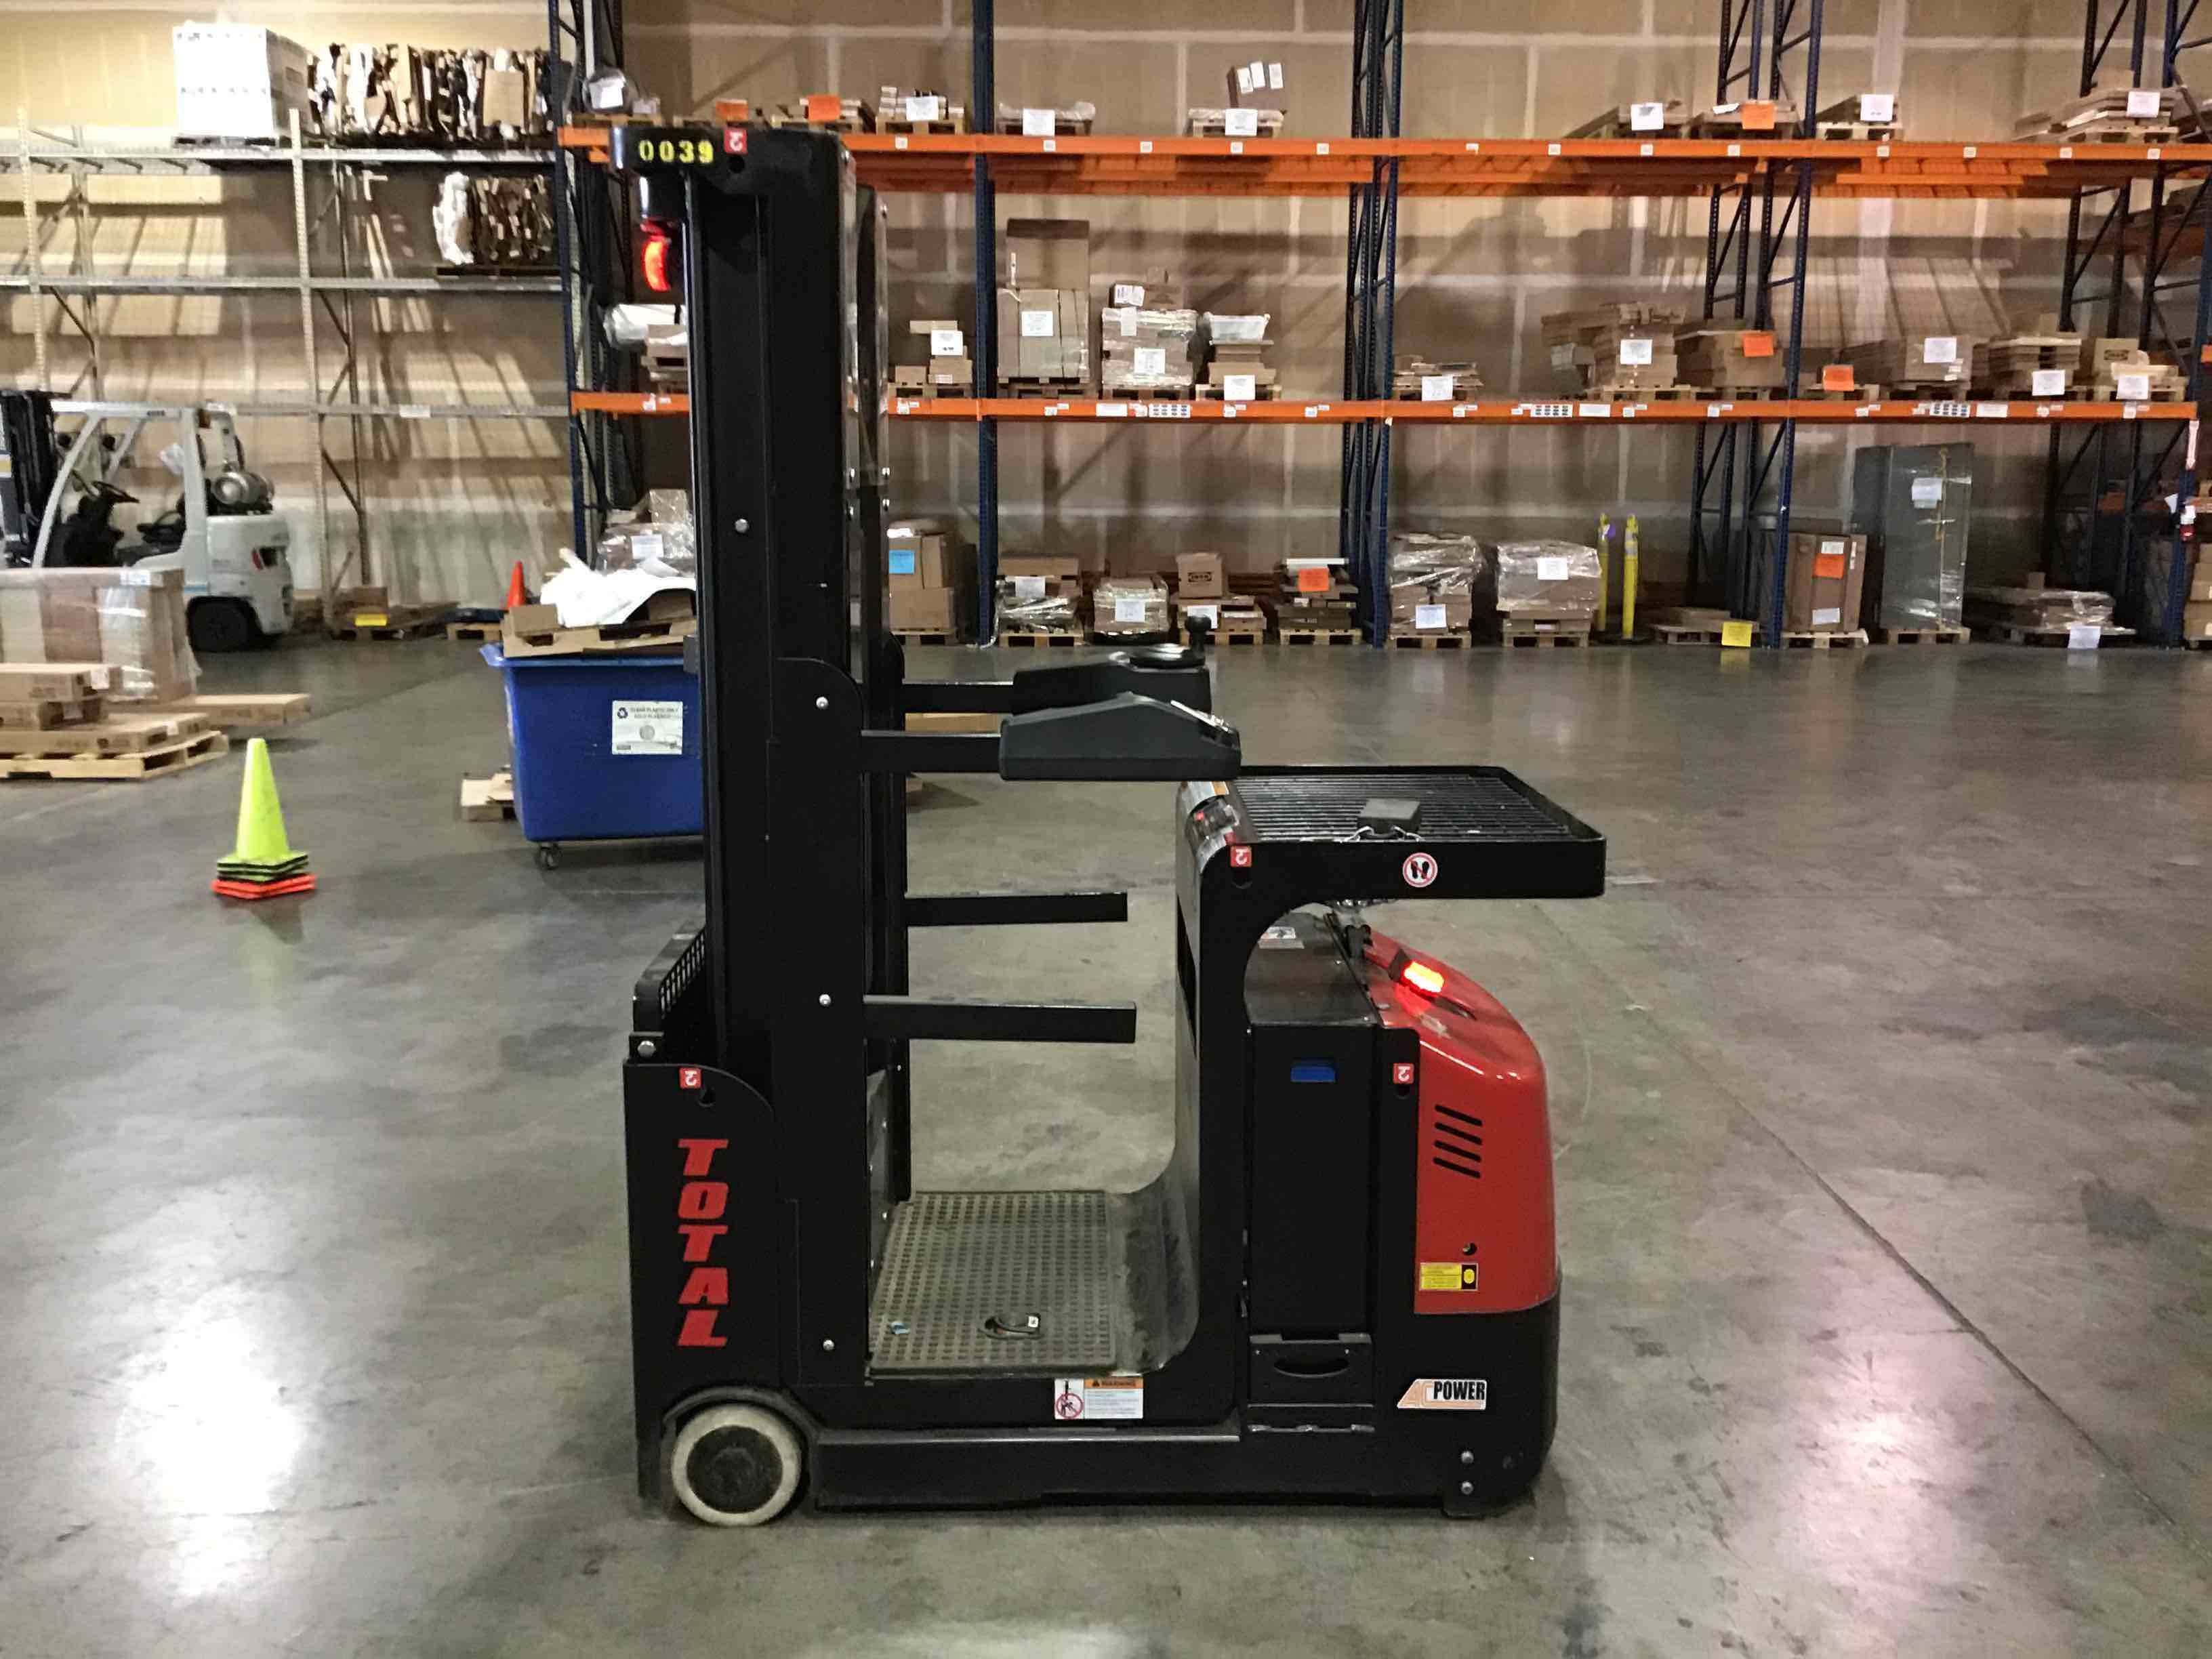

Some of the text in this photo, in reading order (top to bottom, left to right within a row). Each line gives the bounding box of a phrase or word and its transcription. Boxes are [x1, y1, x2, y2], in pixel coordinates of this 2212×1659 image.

[638, 140, 714, 163] 0039
[678, 1139, 729, 1347] TOTAL
[1433, 1380, 1486, 1400] POWER
